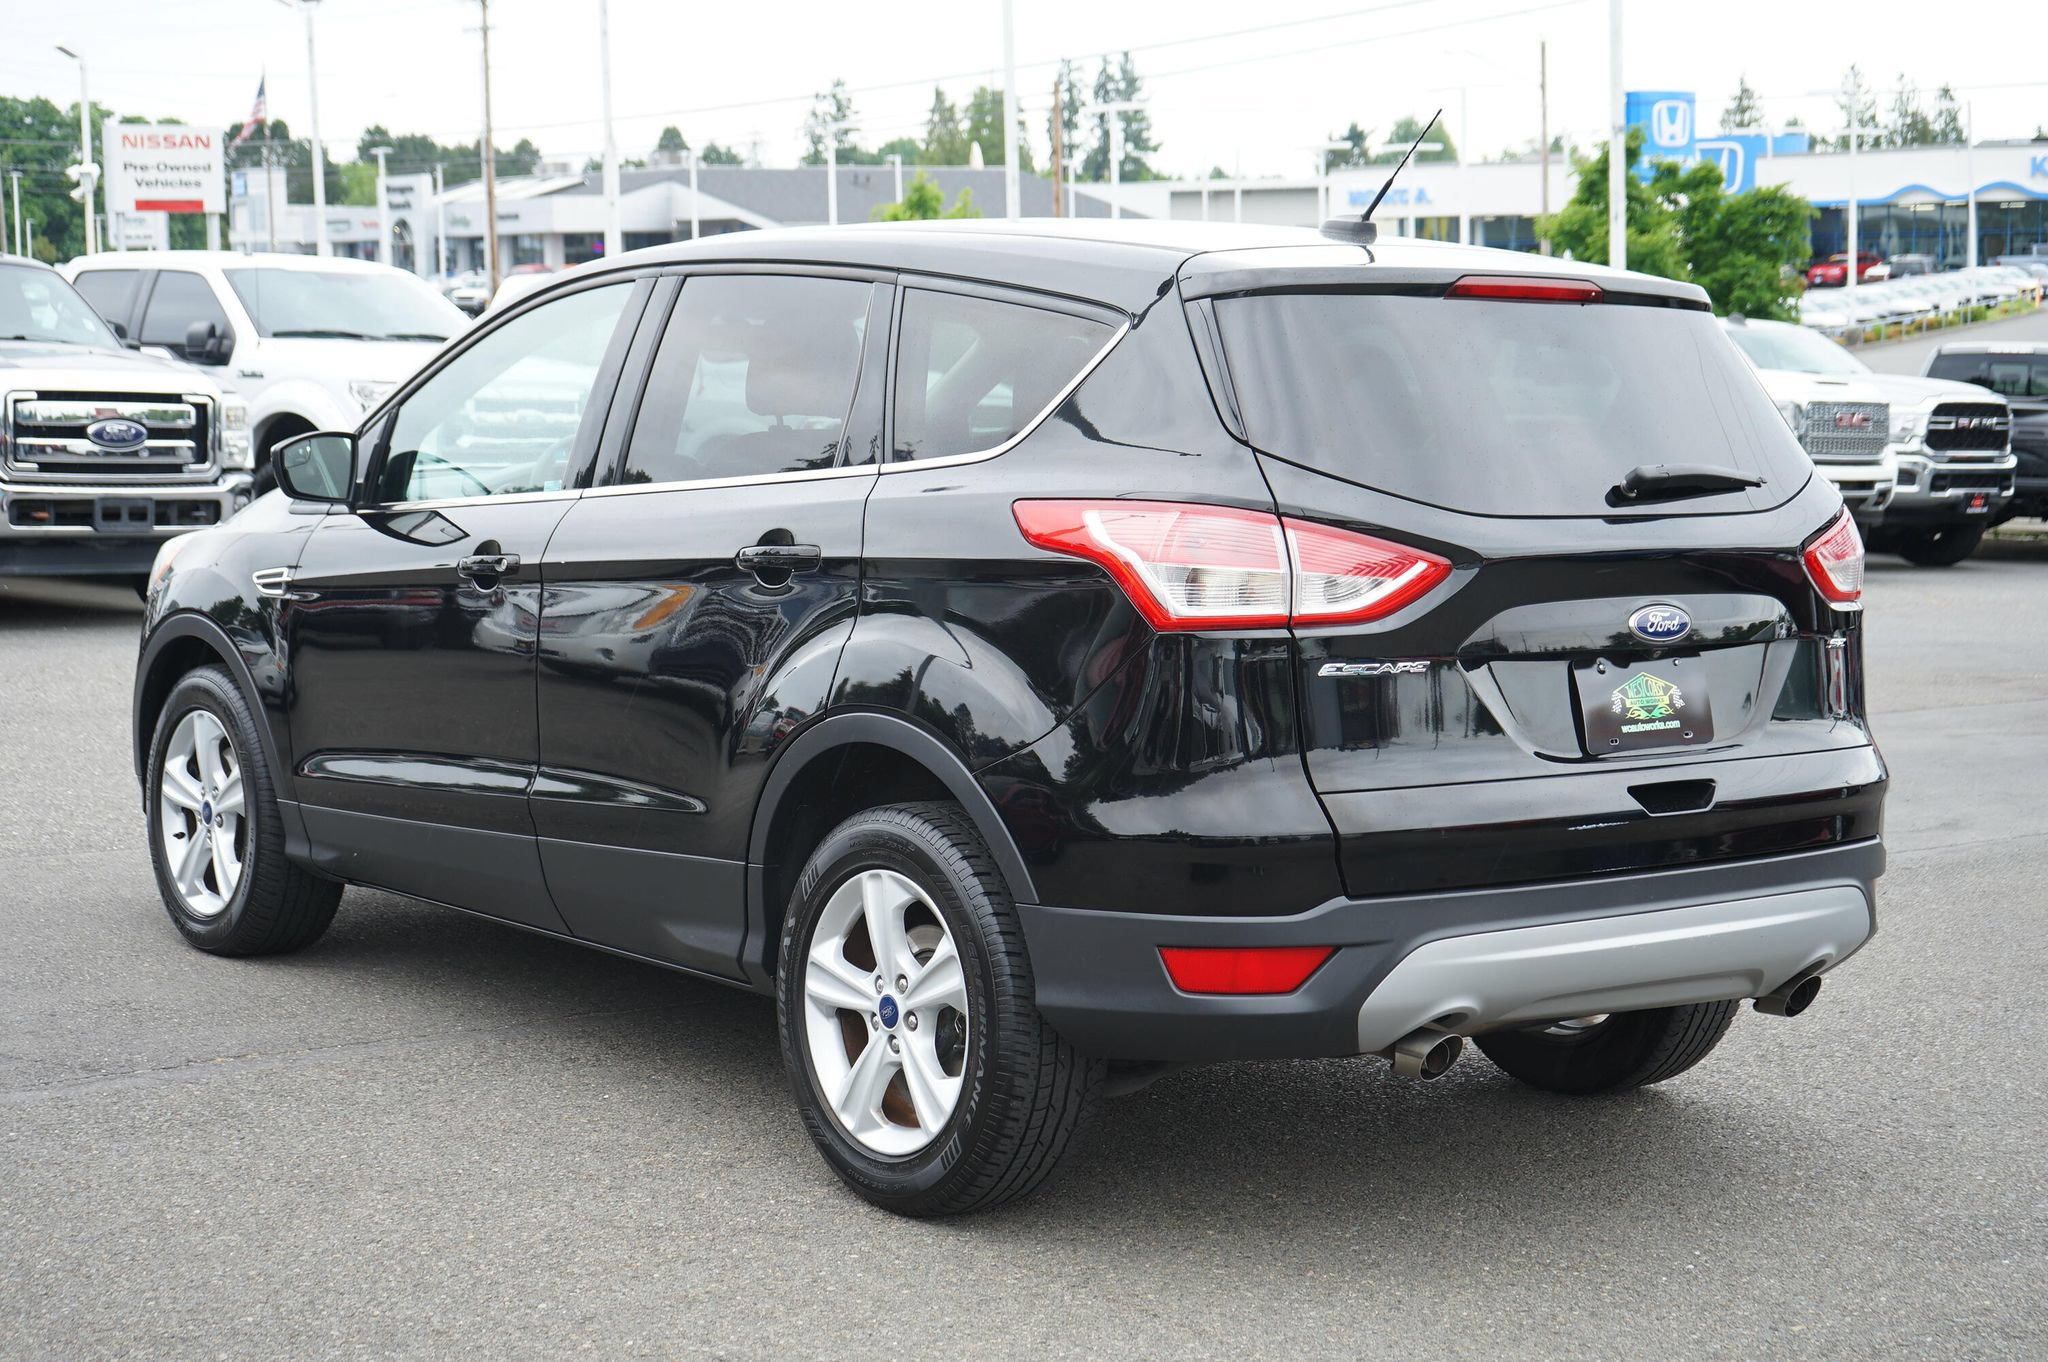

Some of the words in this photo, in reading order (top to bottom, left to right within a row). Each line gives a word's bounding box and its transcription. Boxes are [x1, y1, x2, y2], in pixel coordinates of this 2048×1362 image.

[122, 135, 211, 149] NISSAN
[123, 162, 211, 173] Pre-Owned
[135, 178, 202, 188] Vehicles
[1647, 611, 1680, 633] Ford
[1317, 660, 1431, 677] ESCAPE
[1621, 719, 1680, 733] wcautoworks.com
[959, 922, 987, 1129] PERFORMANCE
